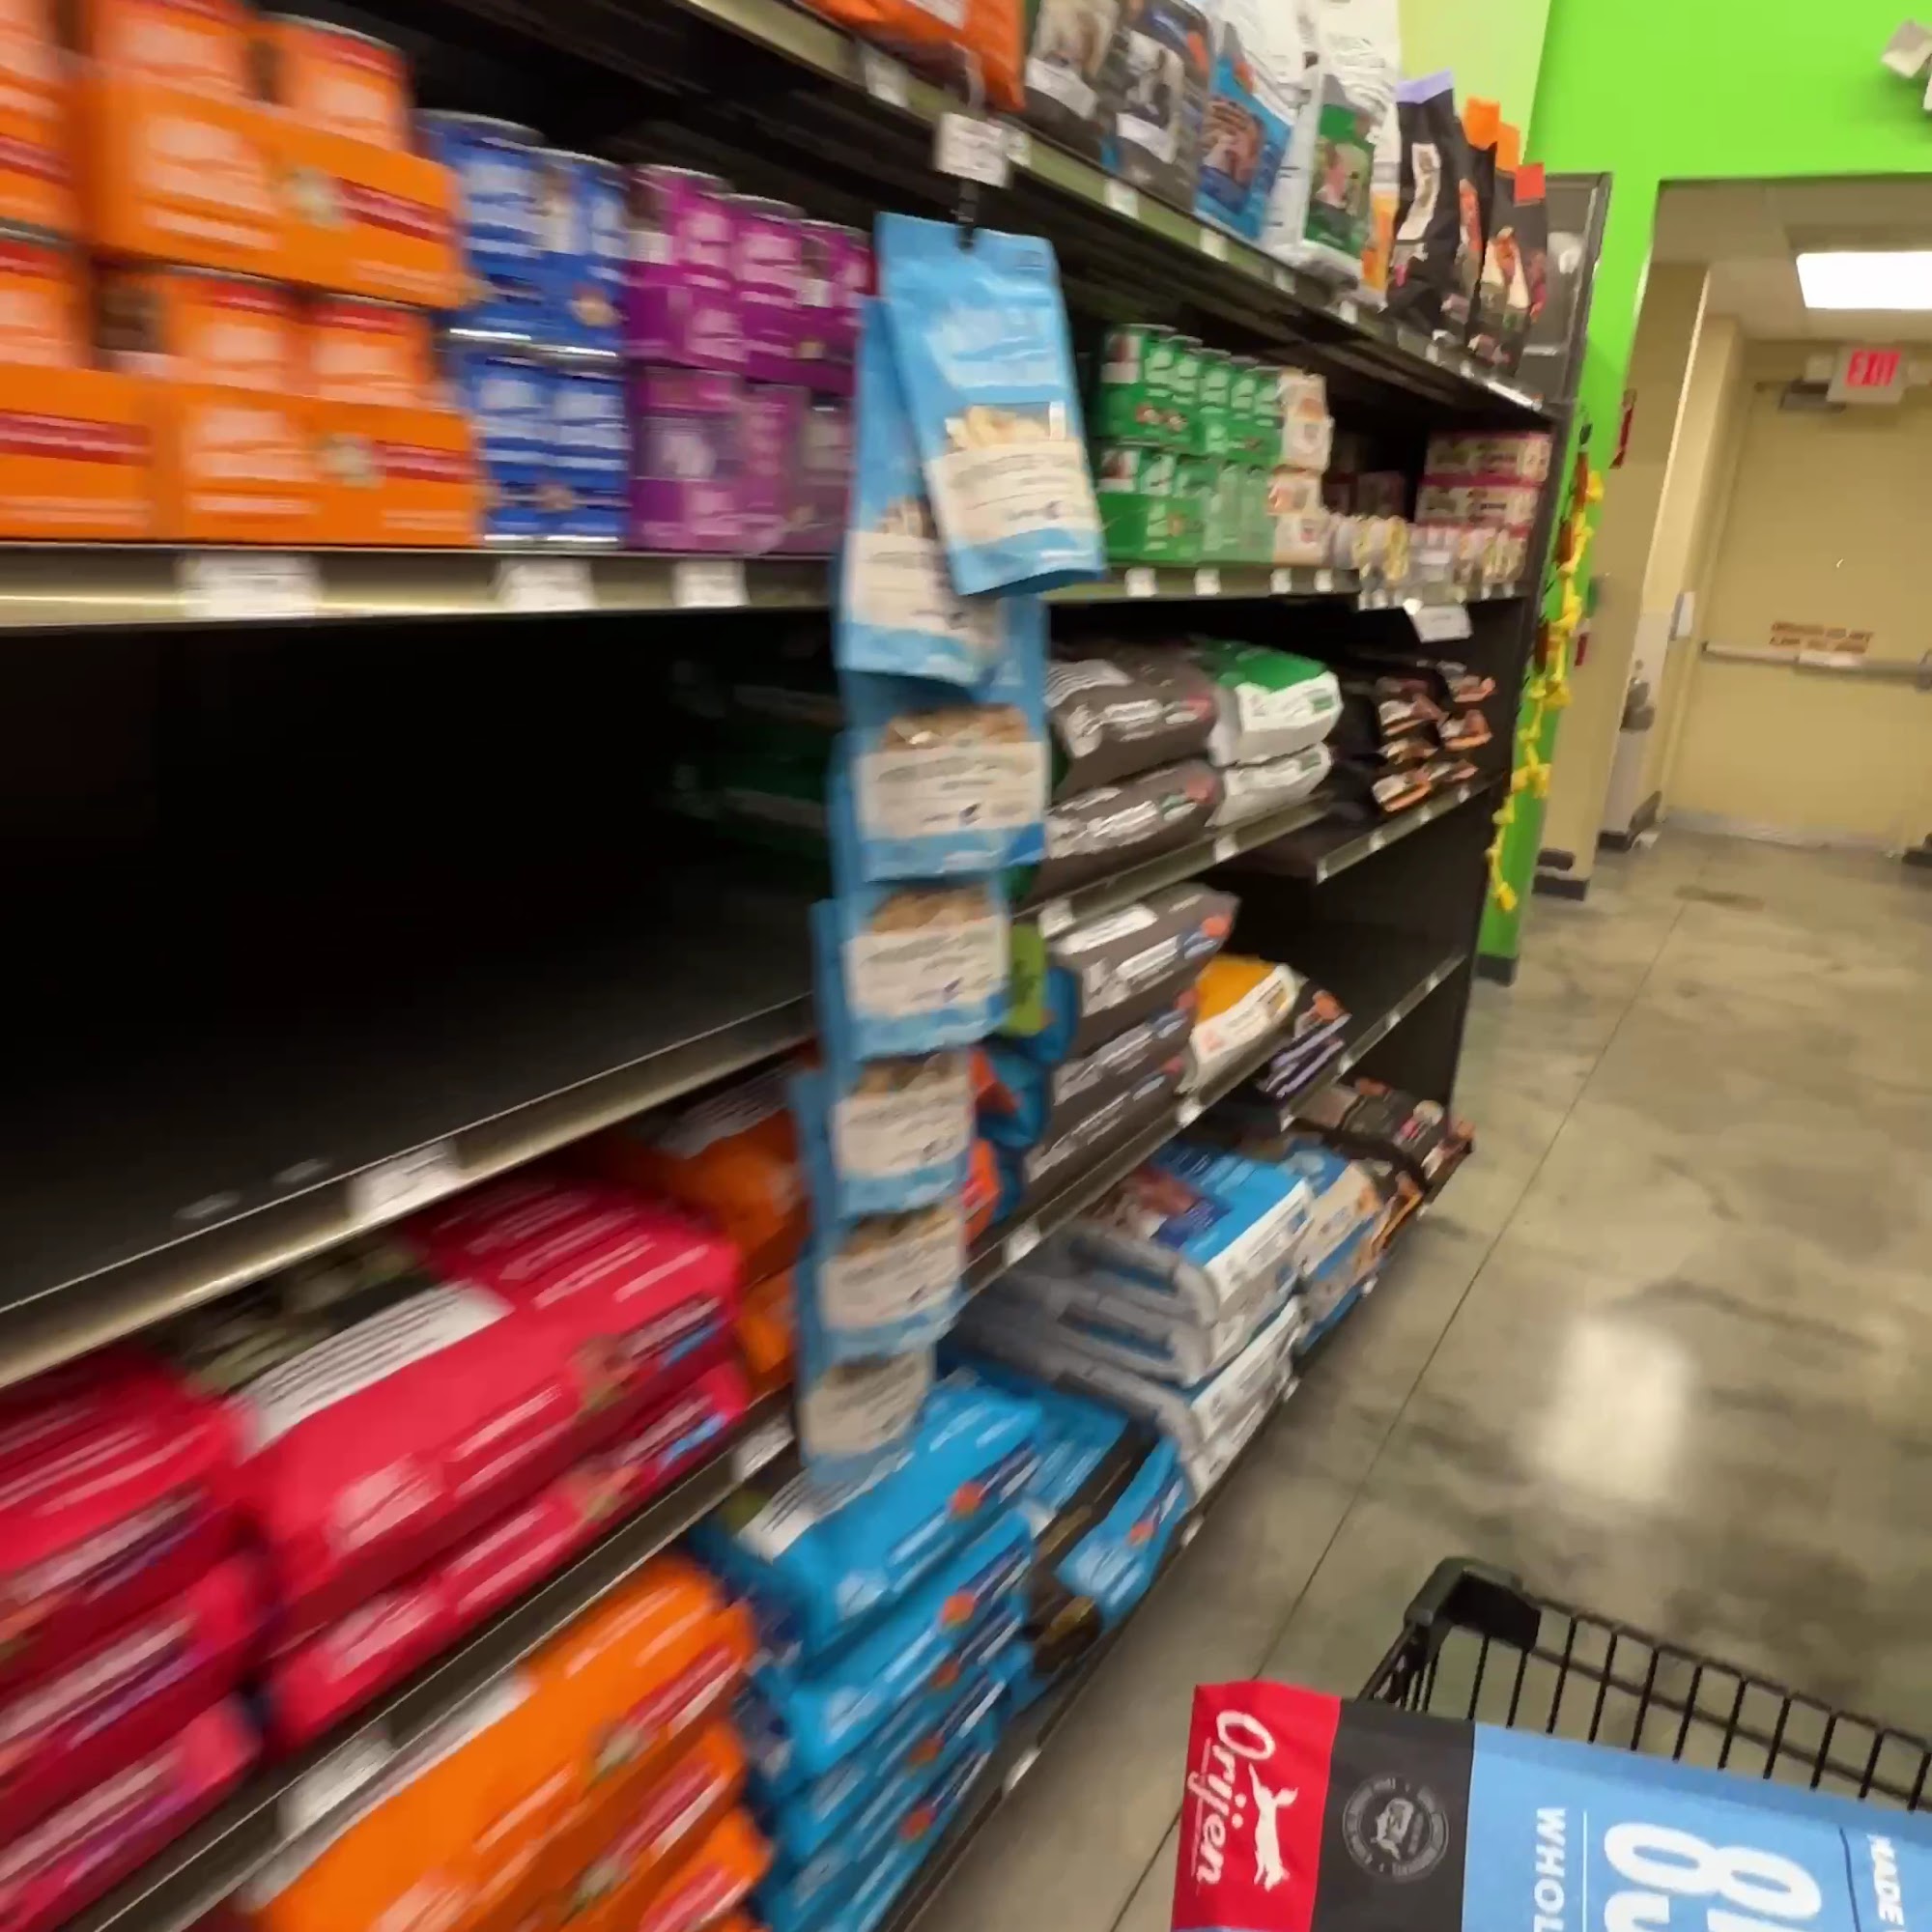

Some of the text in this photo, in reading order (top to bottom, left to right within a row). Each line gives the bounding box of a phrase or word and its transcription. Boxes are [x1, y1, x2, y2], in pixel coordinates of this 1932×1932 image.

[1845, 351, 1901, 387] EXIT
[1187, 1710, 1276, 1884] Orijen
[1866, 1833, 1905, 1926] MADE
